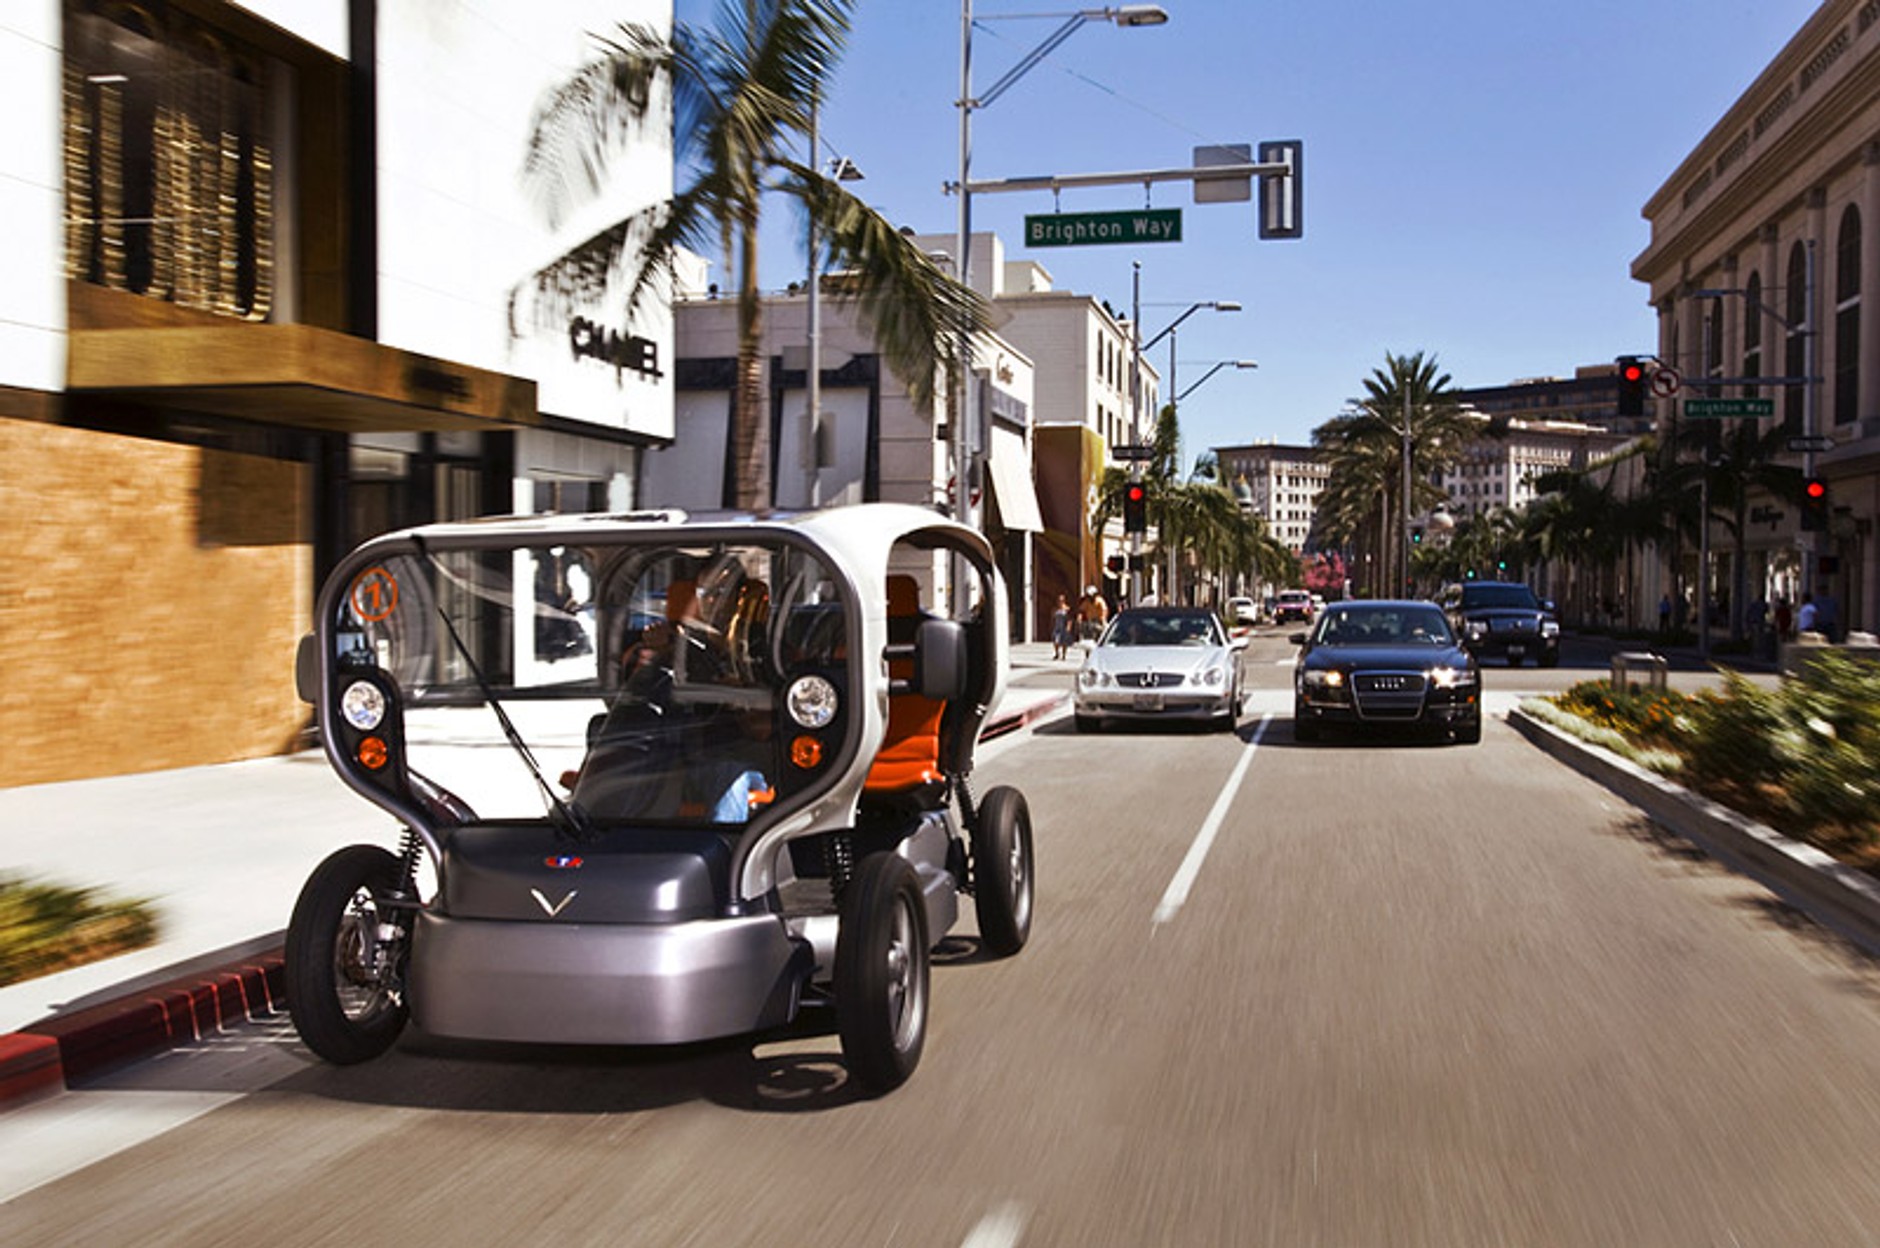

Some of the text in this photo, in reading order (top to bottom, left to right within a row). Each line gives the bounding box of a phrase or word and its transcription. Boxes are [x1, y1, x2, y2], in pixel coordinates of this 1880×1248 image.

[1031, 217, 1174, 244] Brighton Way
[1687, 402, 1771, 415] Brighton Way
[364, 581, 381, 609] 1
